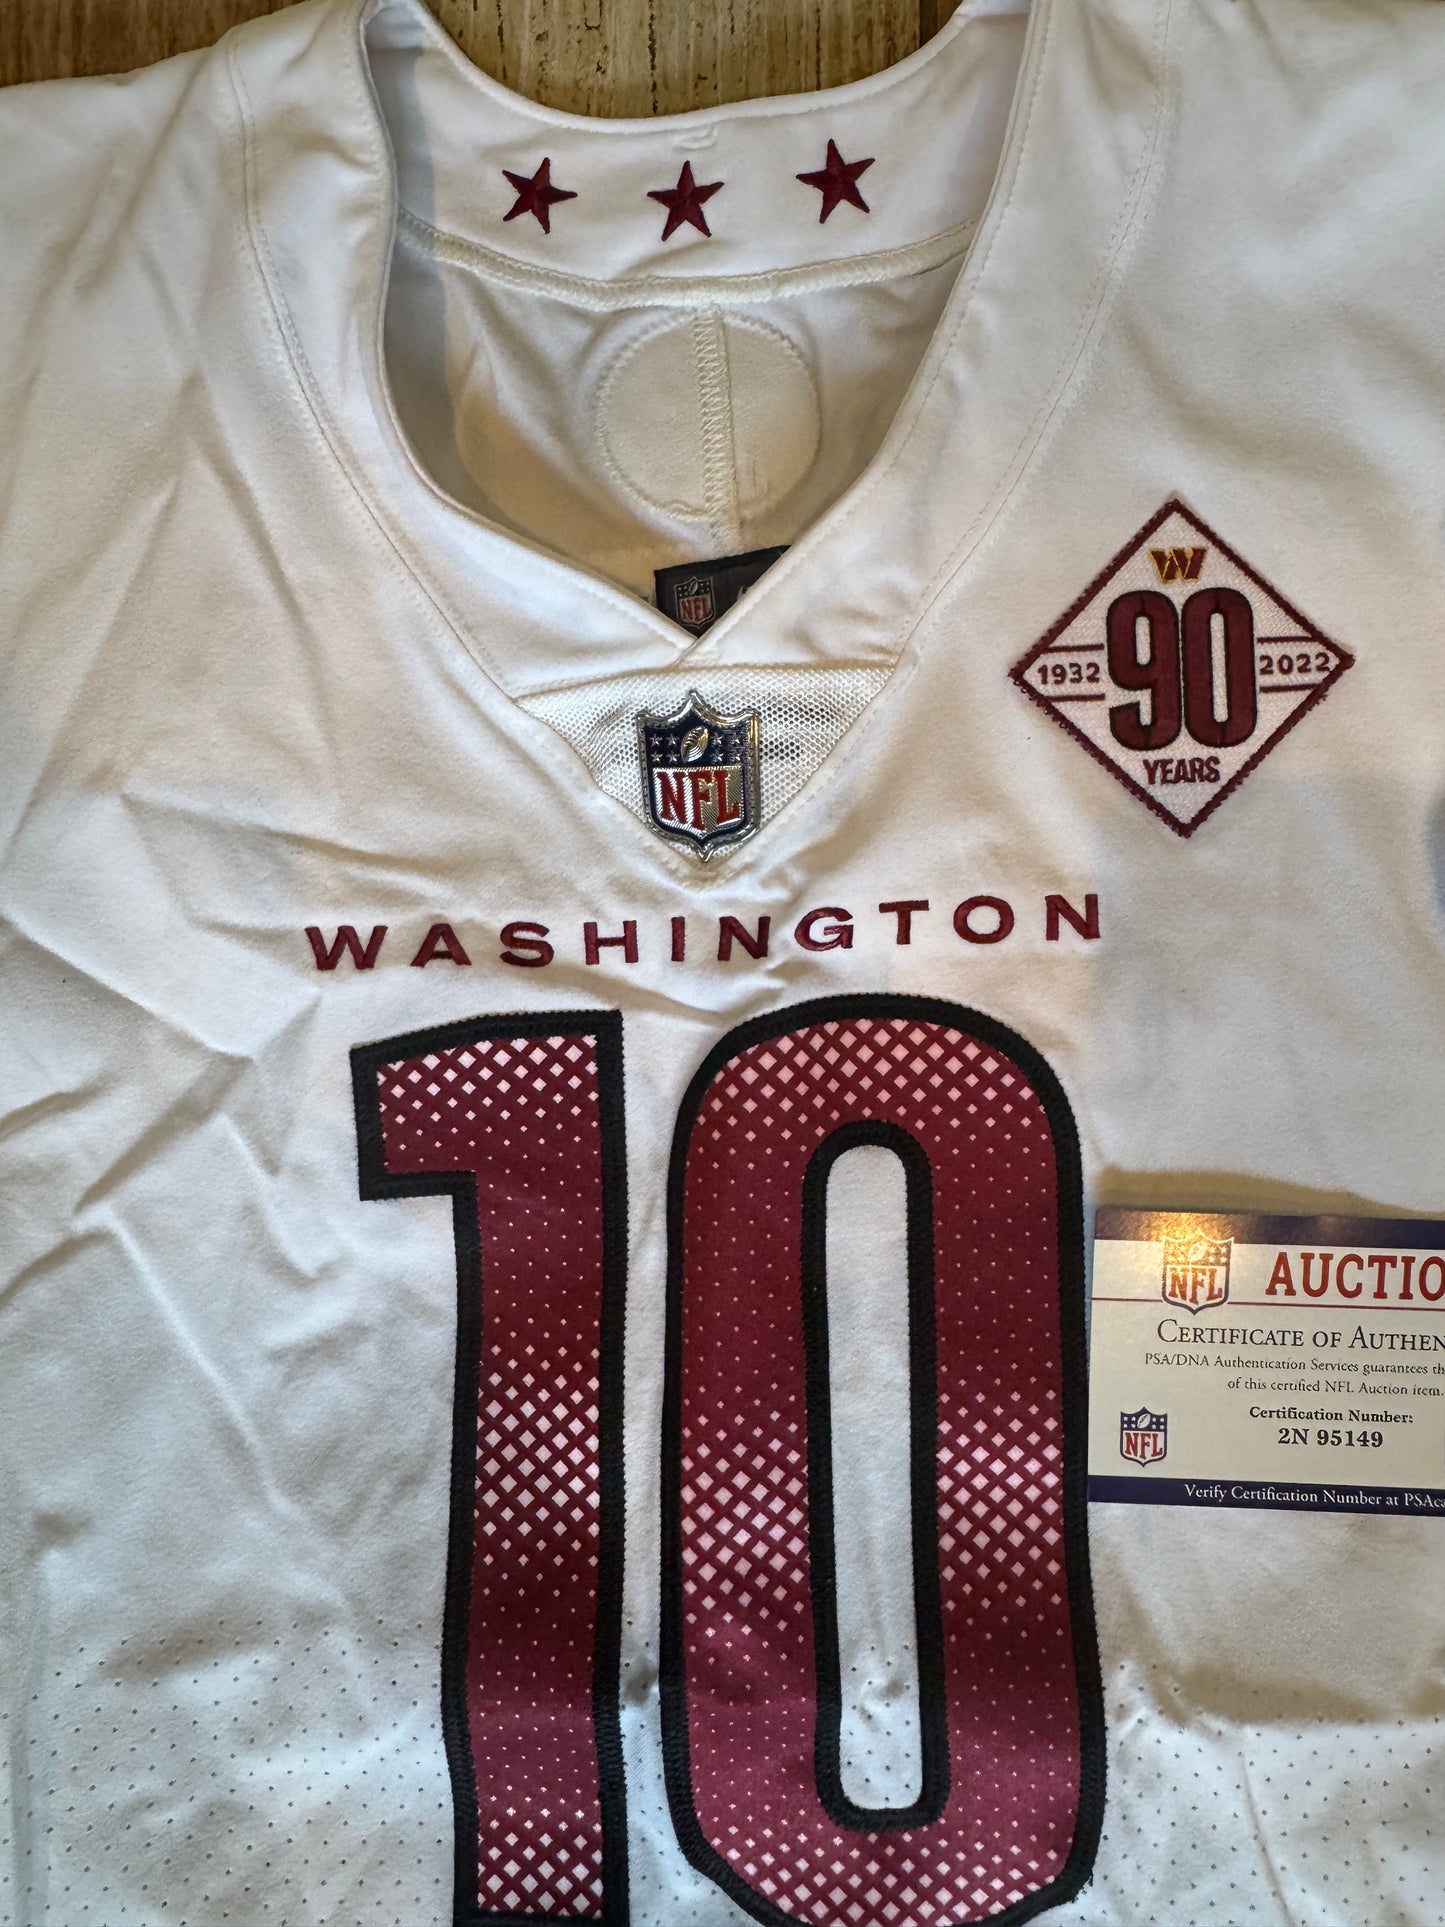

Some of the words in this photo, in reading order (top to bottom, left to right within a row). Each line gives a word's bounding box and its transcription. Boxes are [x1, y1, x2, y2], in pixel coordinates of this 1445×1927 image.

[1151, 547, 1207, 584] W
[681, 597, 713, 623] NFL
[1037, 662, 1101, 686] 1932
[1106, 587, 1258, 751] 90
[1259, 652, 1331, 676] 2022
[1142, 755, 1221, 786] YEARS
[656, 769, 742, 831] NFL
[304, 893, 1102, 971] WASHINGTON
[1167, 1267, 1223, 1305] NFL
[1265, 1251, 1445, 1302] AUCTIO
[1145, 1352, 1210, 1367] PSA/DNA
[1214, 1355, 1306, 1370] Authentication
[1310, 1357, 1359, 1372] Services
[1362, 1363, 1429, 1377] guarantees
[1228, 1377, 1242, 1390] of
[1244, 1377, 1267, 1390] this
[1270, 1378, 1320, 1392] certified
[1325, 1380, 1354, 1393] NFL
[1358, 1381, 1408, 1395] Auction
[1412, 1383, 1444, 1397] item.
[1249, 1406, 1343, 1422] Certification
[1348, 1409, 1413, 1424] Number:
[1124, 1433, 1163, 1460] NFL
[1277, 1428, 1308, 1446] 2N
[1316, 1428, 1384, 1448] 95149
[350, 992, 1107, 1927] 10
[1184, 1483, 1228, 1503] Verify
[1231, 1485, 1318, 1503] Certification
[1323, 1489, 1382, 1505] Number
[1385, 1495, 1399, 1506] at
